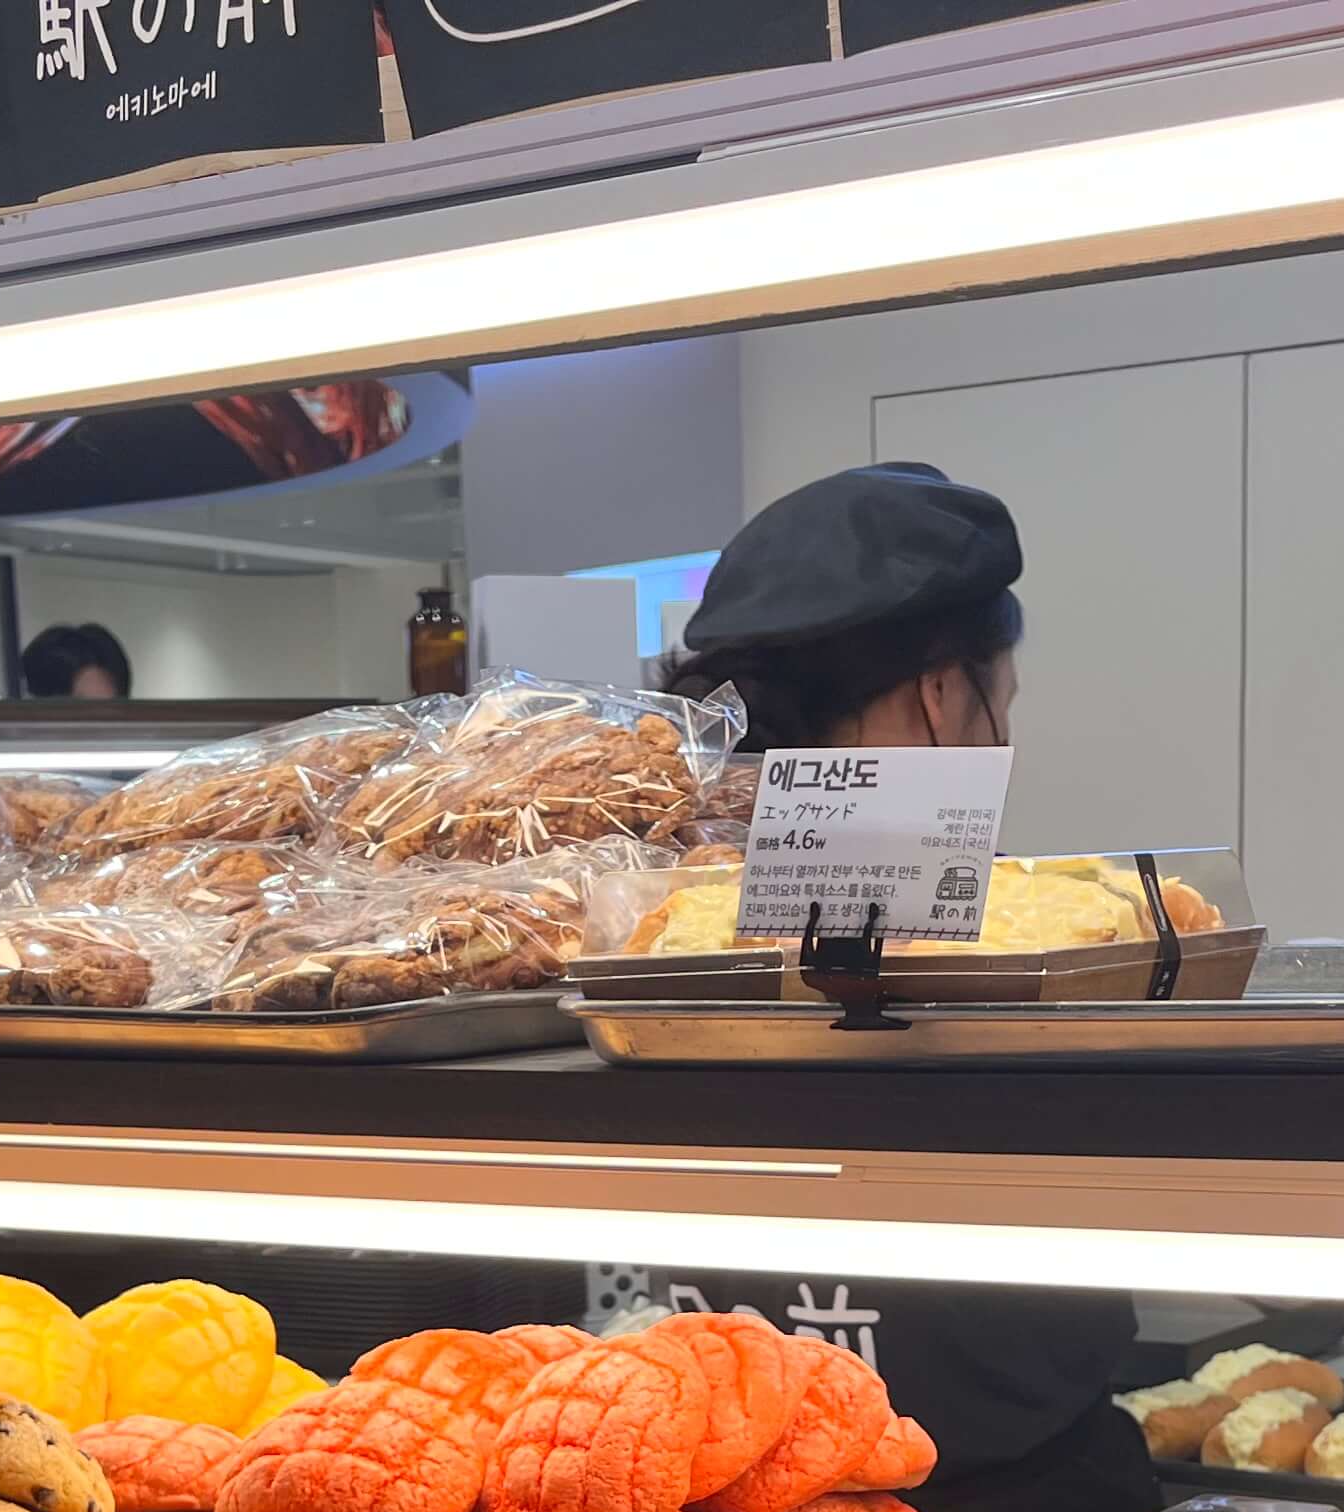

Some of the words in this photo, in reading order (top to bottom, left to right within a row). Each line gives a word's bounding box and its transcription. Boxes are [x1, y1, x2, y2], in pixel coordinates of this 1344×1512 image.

[105, 70, 216, 122] 에키노마에
[769, 758, 879, 792] 에그산도
[760, 802, 856, 821] エッグサンド
[750, 865, 794, 878] 하나부터
[796, 865, 829, 878] 열까지
[831, 864, 853, 878] 전부
[898, 866, 921, 880] 만든
[747, 884, 800, 897] 에그마요와
[805, 884, 858, 897] 특제소스를
[745, 903, 766, 917] 진짜
[929, 904, 977, 921] 駅の前
